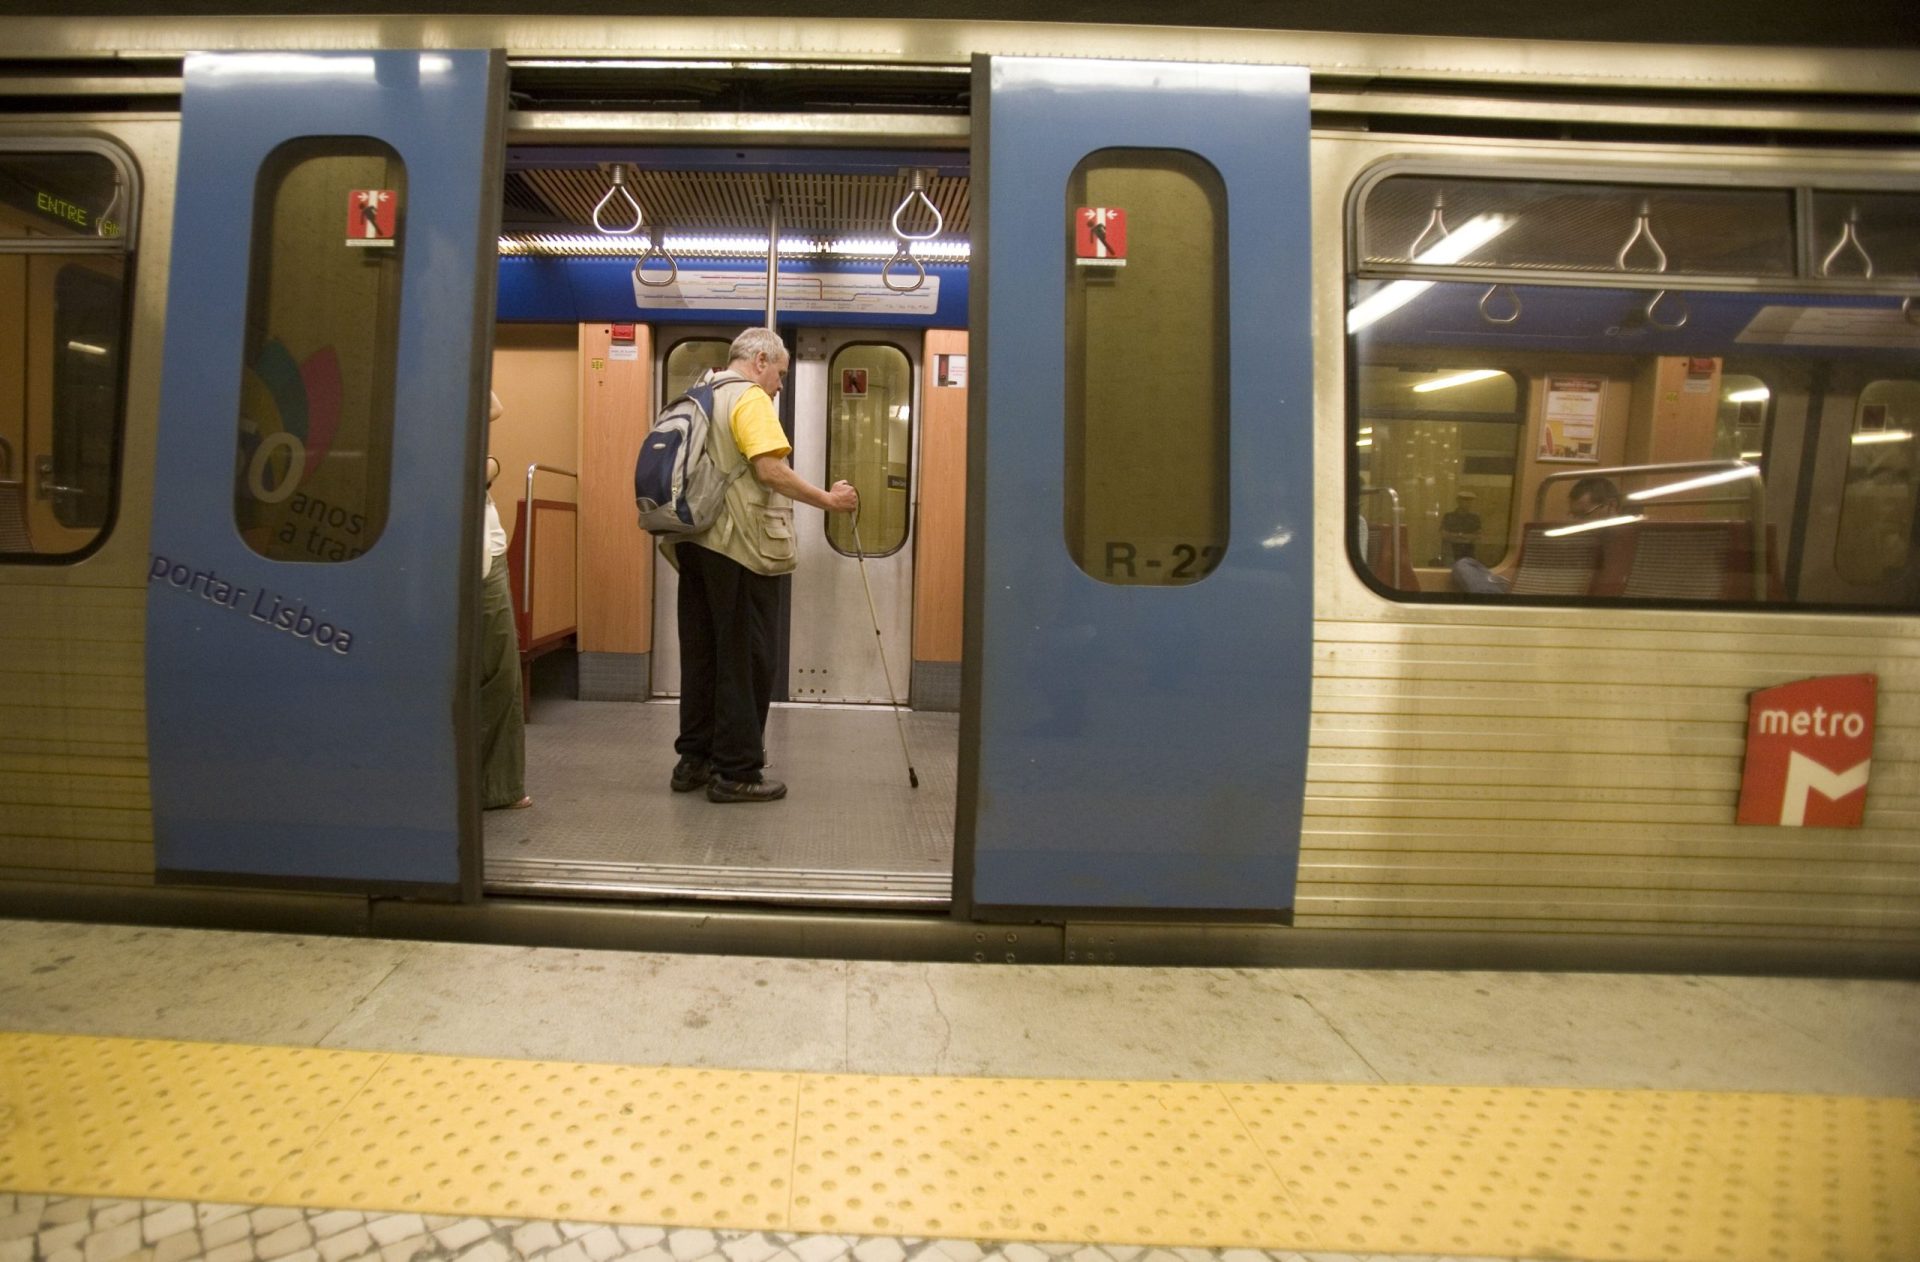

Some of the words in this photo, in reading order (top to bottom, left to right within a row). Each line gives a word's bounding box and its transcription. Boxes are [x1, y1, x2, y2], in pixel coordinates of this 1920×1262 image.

[37, 191, 88, 226] ENTRE
[290, 492, 368, 535] anos
[278, 521, 297, 544] a
[147, 555, 248, 609] portar
[249, 587, 354, 655] Lisboa
[1758, 705, 1866, 739] metro
